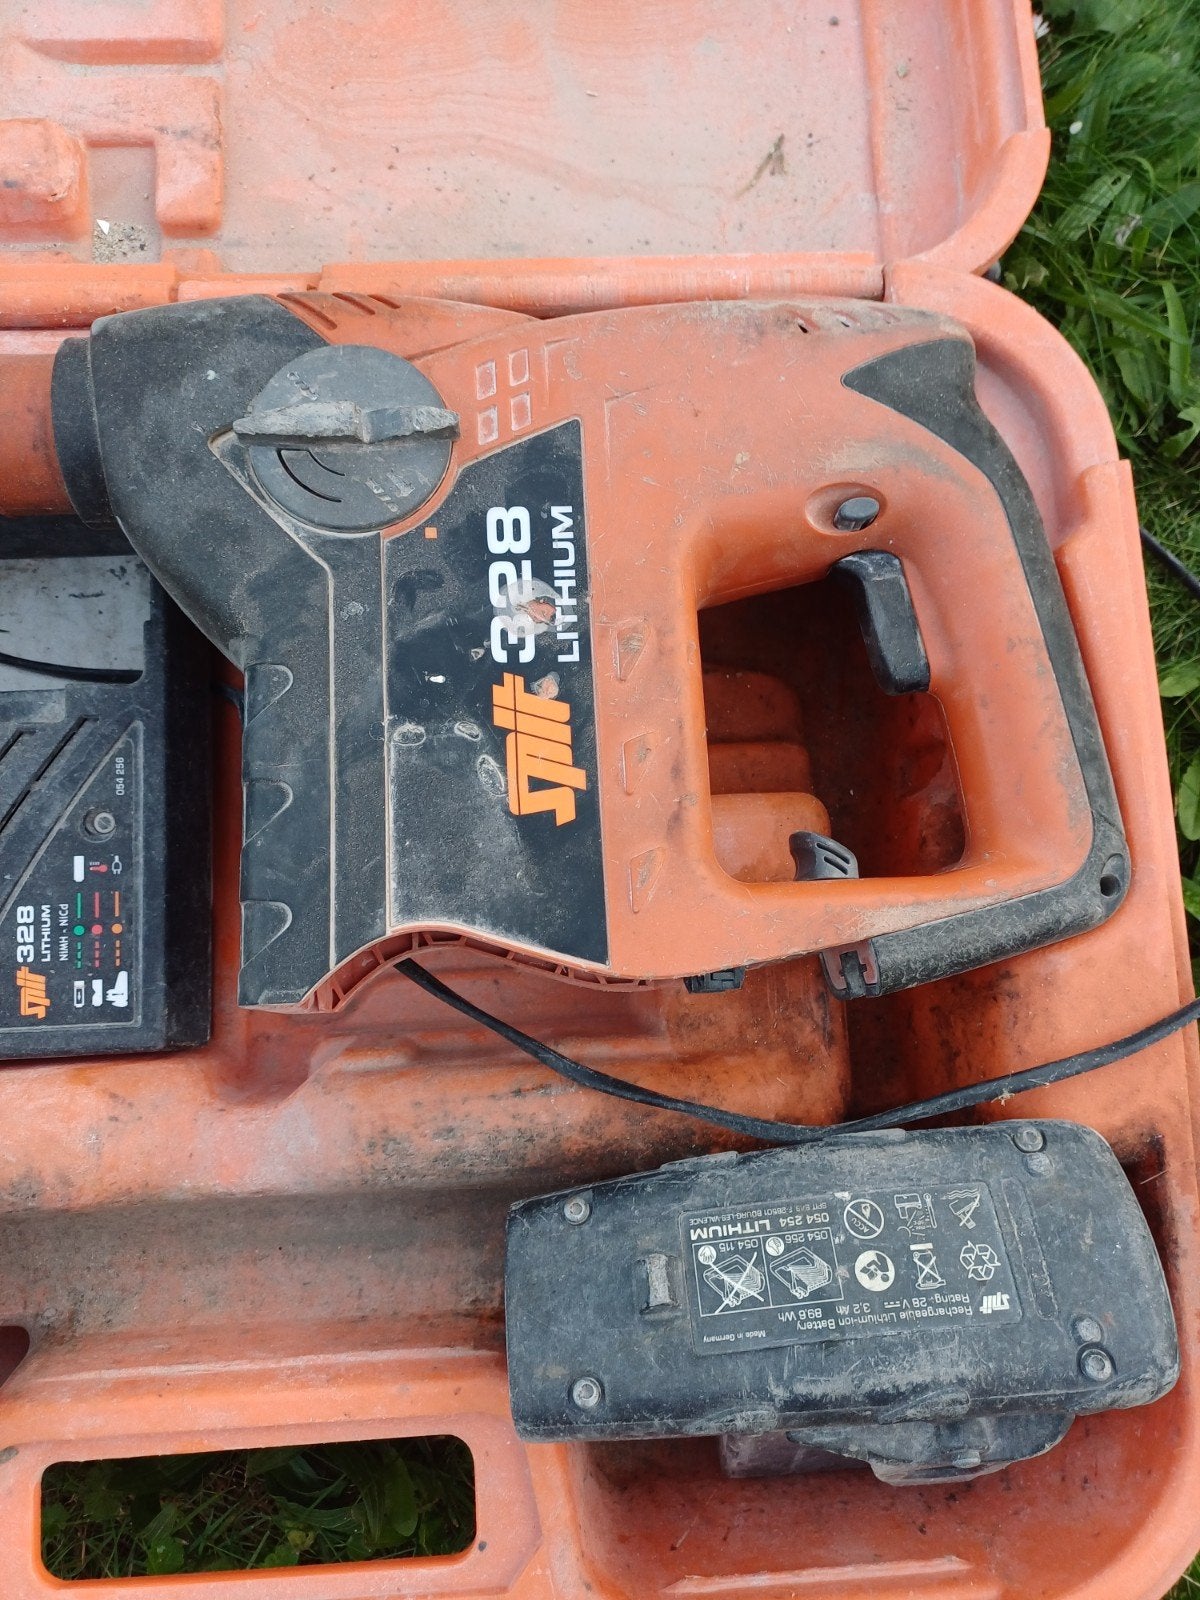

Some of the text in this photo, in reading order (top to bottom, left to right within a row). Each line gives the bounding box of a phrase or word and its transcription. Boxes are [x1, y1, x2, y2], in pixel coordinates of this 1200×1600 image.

[486, 506, 536, 663] 328
[551, 505, 579, 662] LITHIUM
[116, 757, 125, 795] 054 256
[16, 906, 34, 962] 328
[41, 905, 51, 962] LITHIUM
[690, 1212, 829, 1241] 054 254 LITHIUM
[851, 1216, 870, 1235] ACCU
[784, 1230, 828, 1244] 054 256
[718, 1238, 759, 1252] 054 115
[853, 1302, 870, 1315] 3,2
[902, 1298, 910, 1309] V
[912, 1297, 927, 1308] 28
[778, 1311, 796, 1323] Wh
[796, 1304, 972, 1332] Rechargeable Lithium-ion Battery
[798, 1308, 822, 1320] 89,6
[836, 1304, 850, 1317] Ah
[703, 1329, 765, 1344] Made in Germany
